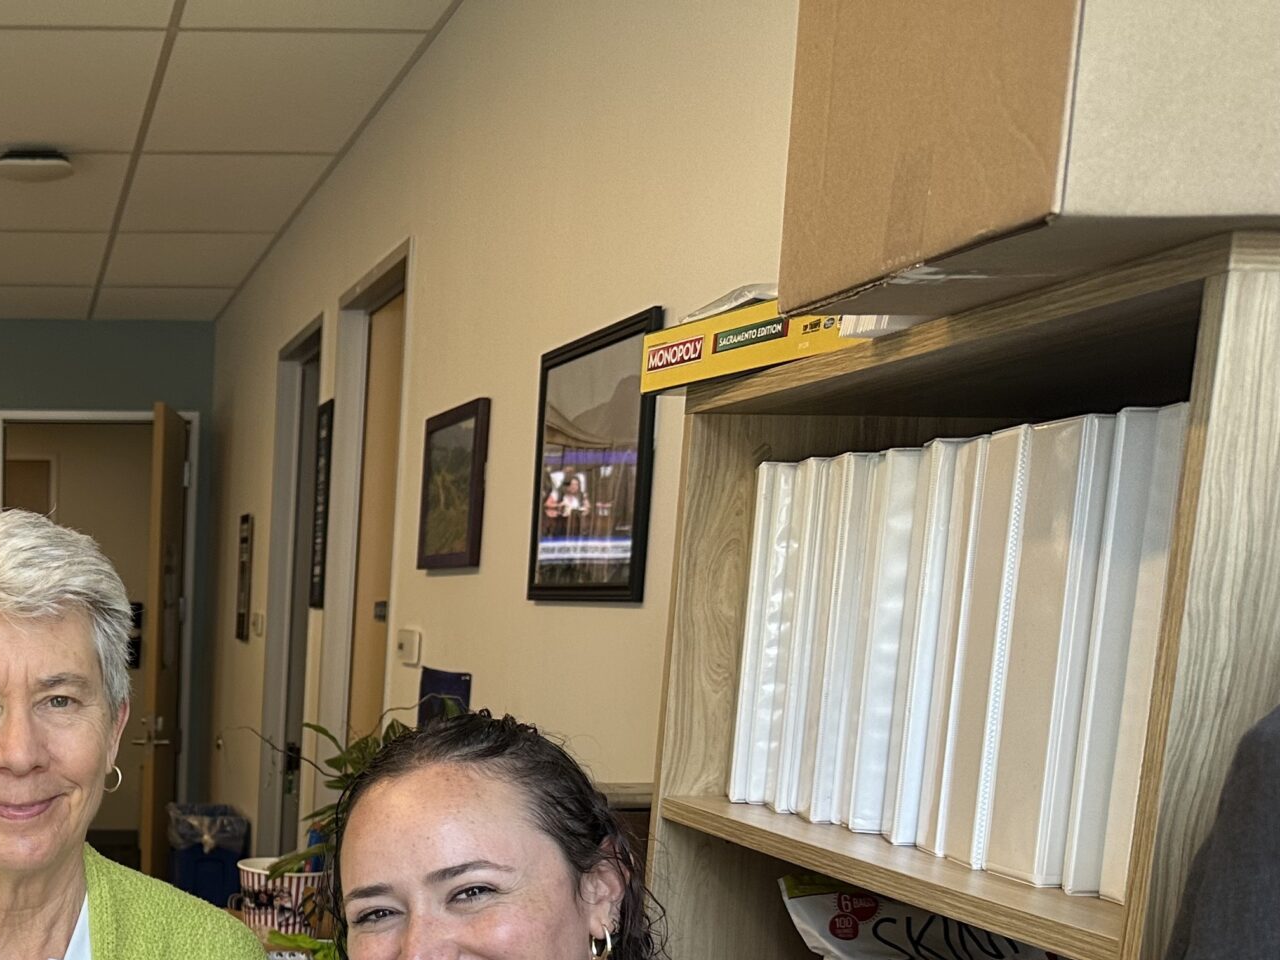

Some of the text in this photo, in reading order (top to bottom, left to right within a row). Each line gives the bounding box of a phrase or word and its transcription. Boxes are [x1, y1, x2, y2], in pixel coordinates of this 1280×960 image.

[718, 329, 757, 347] SACRAMENTO
[757, 322, 783, 339] EDITION
[648, 340, 702, 369] MONOPOLY
[841, 894, 852, 913] 6
